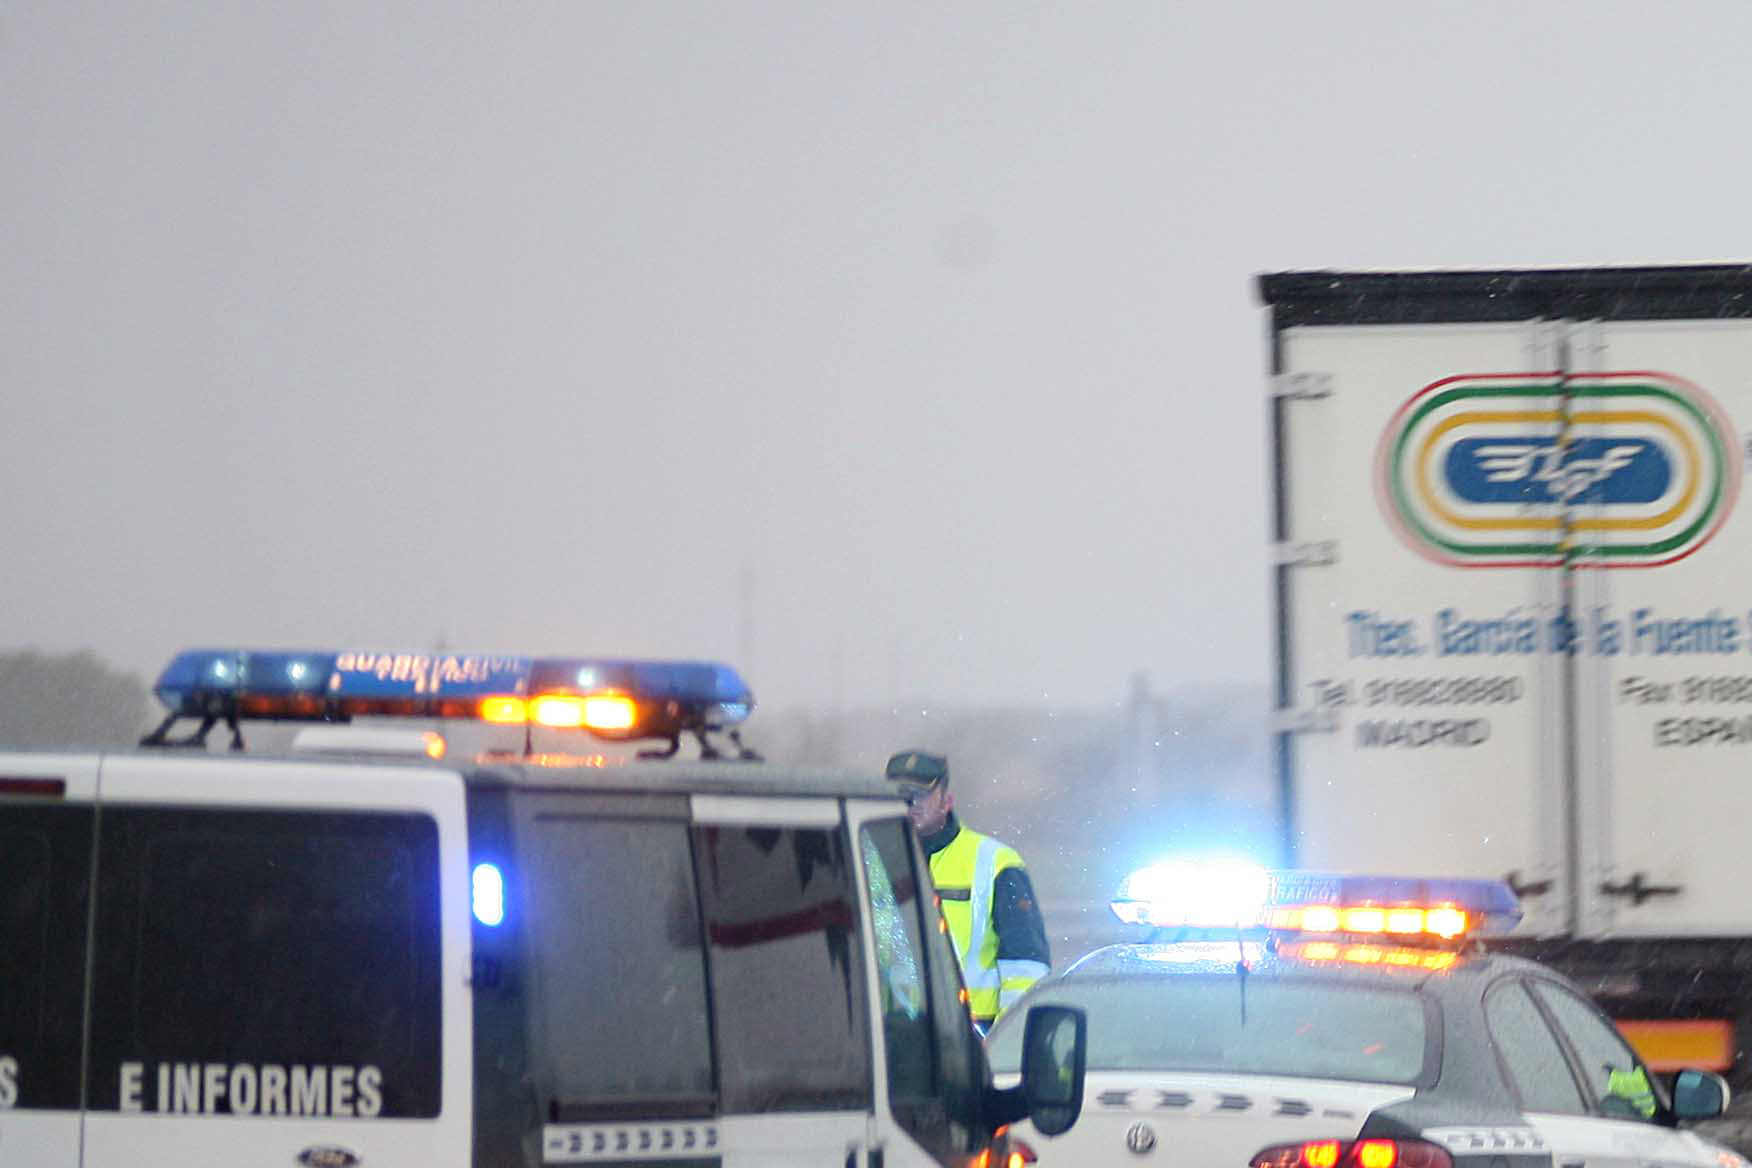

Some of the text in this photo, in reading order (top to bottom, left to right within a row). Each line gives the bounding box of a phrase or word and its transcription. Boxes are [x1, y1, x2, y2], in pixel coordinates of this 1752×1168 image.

[1631, 608, 1742, 656] Fuente
[1356, 718, 1490, 748] MADRID
[119, 1061, 143, 1112] E
[158, 1062, 383, 1117] INFORMES
